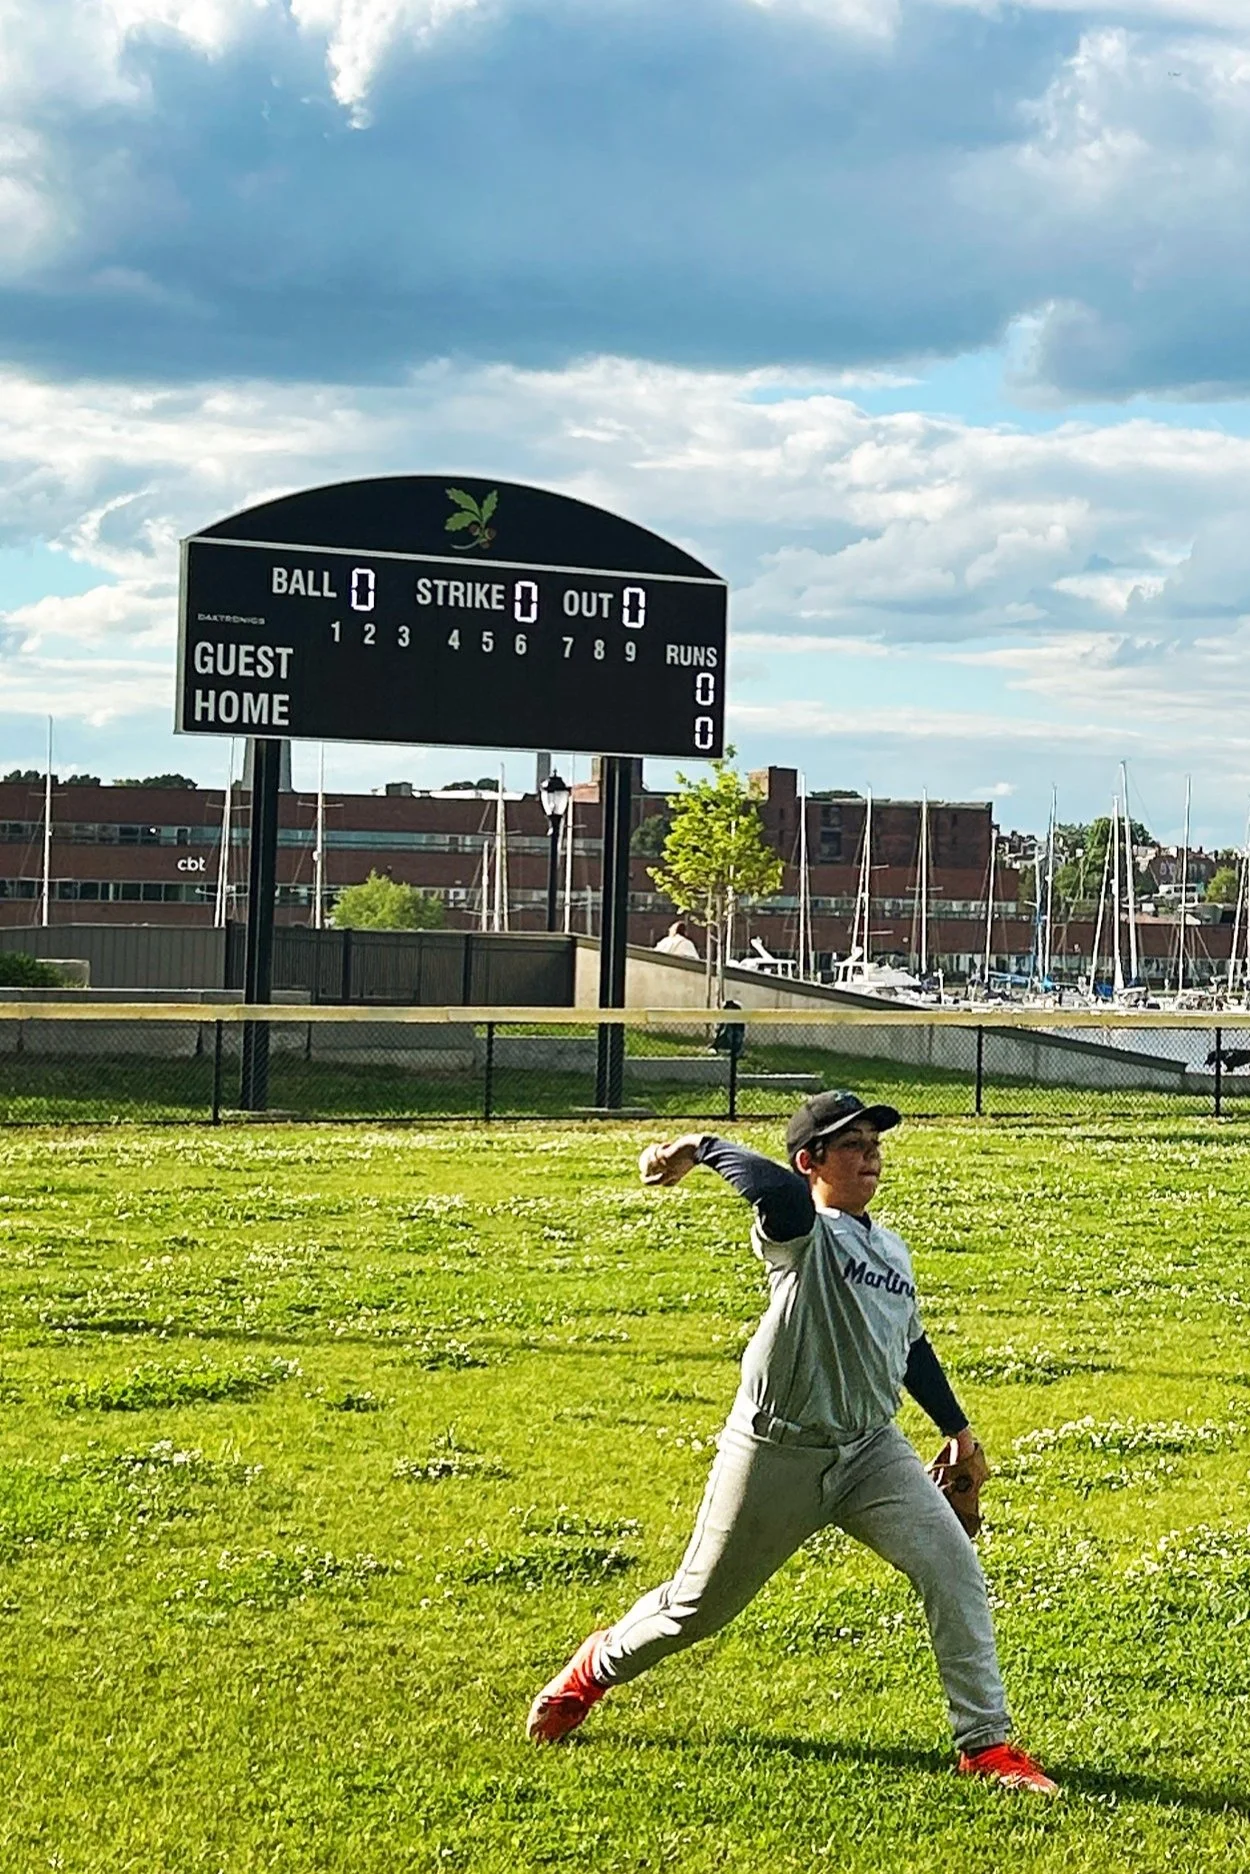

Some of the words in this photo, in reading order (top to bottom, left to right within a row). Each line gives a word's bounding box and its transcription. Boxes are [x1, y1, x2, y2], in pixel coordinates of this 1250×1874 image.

[273, 568, 337, 597] BALL
[351, 568, 375, 611] 0
[417, 578, 504, 610] STRIKE
[514, 581, 537, 623] 0
[198, 614, 265, 624] DAKTRONICS
[564, 590, 613, 618] OUT
[622, 587, 645, 628] 0
[331, 621, 340, 642] 1
[364, 624, 375, 644] 2
[398, 626, 409, 647] 3
[448, 630, 460, 649] 4
[482, 632, 493, 652] 5
[516, 634, 526, 655] 6
[563, 637, 573, 657] 7
[594, 640, 604, 659] 8
[626, 642, 635, 661] 9
[667, 645, 717, 667] RUNS
[195, 642, 293, 678] GUEST
[696, 673, 714, 705] 0
[195, 690, 289, 725] HOME
[695, 717, 713, 749] 0
[177, 856, 206, 871] cbt
